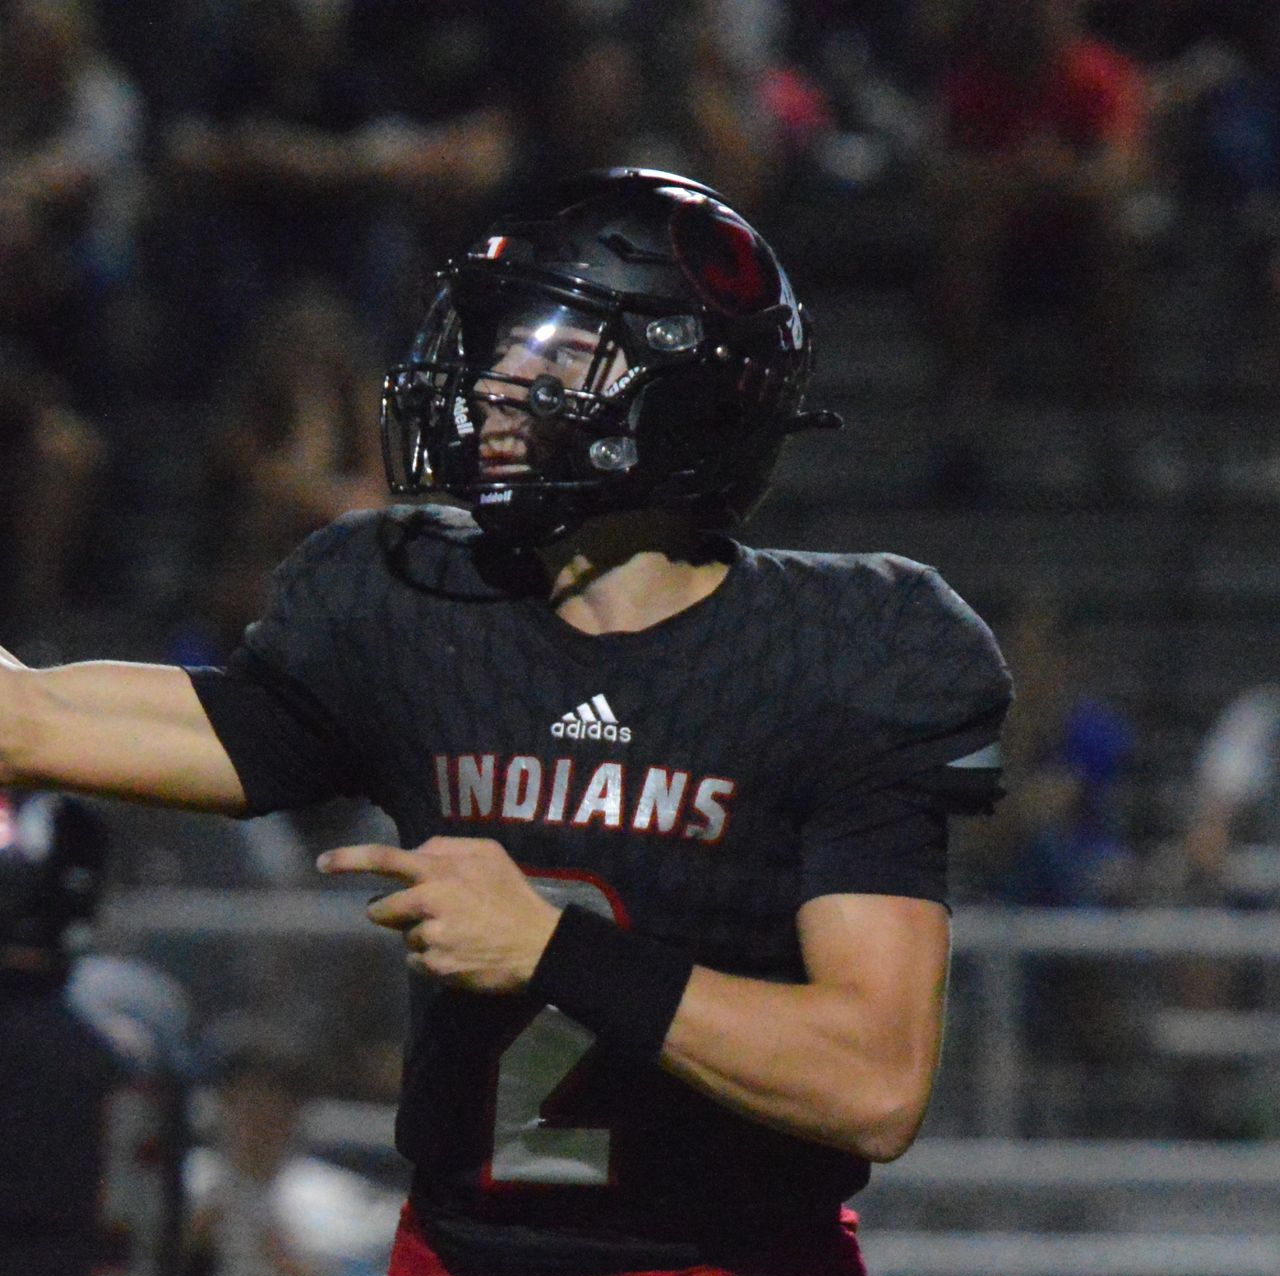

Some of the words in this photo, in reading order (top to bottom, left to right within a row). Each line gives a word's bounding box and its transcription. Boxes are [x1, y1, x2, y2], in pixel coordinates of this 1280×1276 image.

[550, 721, 632, 743] adidas
[433, 752, 736, 846] INDIANS
[481, 867, 633, 1192] 2
